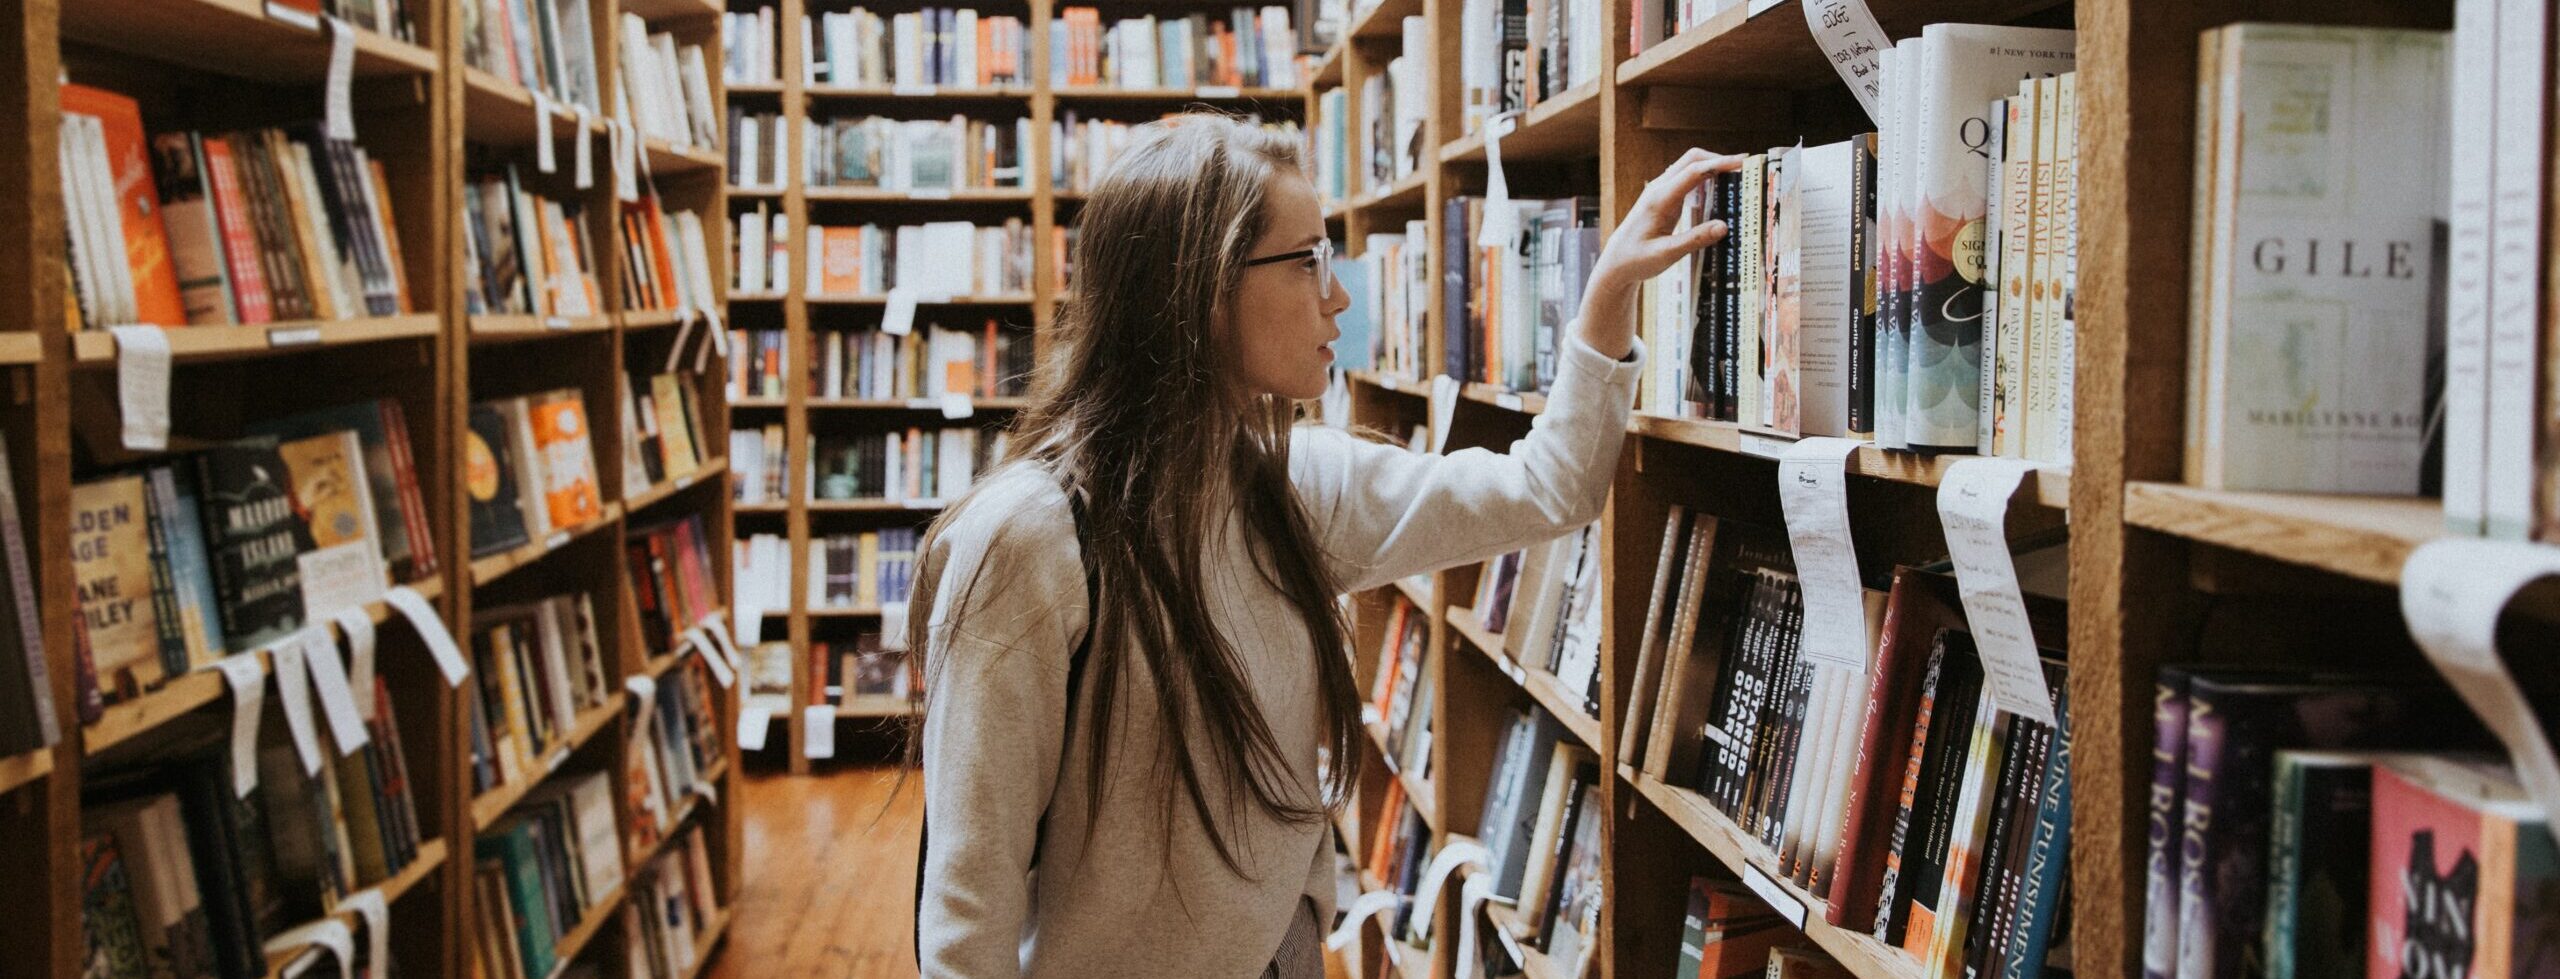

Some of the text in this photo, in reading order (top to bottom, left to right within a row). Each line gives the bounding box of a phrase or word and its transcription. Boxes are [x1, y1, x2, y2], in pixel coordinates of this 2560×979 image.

[1822, 5, 1850, 29] EDGE
[2004, 48, 2025, 57] NEW
[2029, 49, 2056, 59] YORK
[1853, 147, 1863, 272] Monument Road
[2012, 161, 2029, 254] ISHMAEL
[2035, 162, 2050, 256] ISHMAEL
[2052, 159, 2069, 255] ISHMAEL
[1726, 248, 1734, 276] FAIL
[1966, 254, 1984, 266] CO
[2253, 237, 2414, 279] GILE
[1725, 294, 1733, 356] MATTHEW
[2049, 310, 2060, 361] DANIEL
[1724, 358, 1733, 396] QUICK
[1851, 348, 1859, 390] Quimby
[2007, 308, 2019, 405] DANIEL QUINN
[2029, 311, 2042, 412] DANIEL QUINN
[1981, 350, 1992, 414] Quindlen
[1769, 630, 1790, 710] IMPERFECTIONISTS
[1777, 634, 1797, 714] IMPERFECTIONISTS
[1874, 631, 1891, 680] Devil
[1728, 674, 1754, 771] OTARED
[1737, 680, 1763, 777] OTARED
[1854, 693, 1877, 776] Jerusalem
[2188, 695, 2213, 737] M
[1769, 722, 1789, 803] Tom Rachman
[2005, 741, 2019, 786] RAKHA
[2028, 729, 2038, 755] WHY
[2038, 734, 2049, 761] WHY
[1780, 727, 1800, 808] Tom Rachman
[2018, 769, 2030, 799] CAME
[2030, 775, 2041, 805] CAME
[1925, 816, 1937, 859] Childhood
[1935, 822, 1948, 865] Childhood
[1978, 839, 2000, 925] CROCODILES
[1998, 868, 2010, 901] MARY
[2009, 875, 2021, 909] MARY
